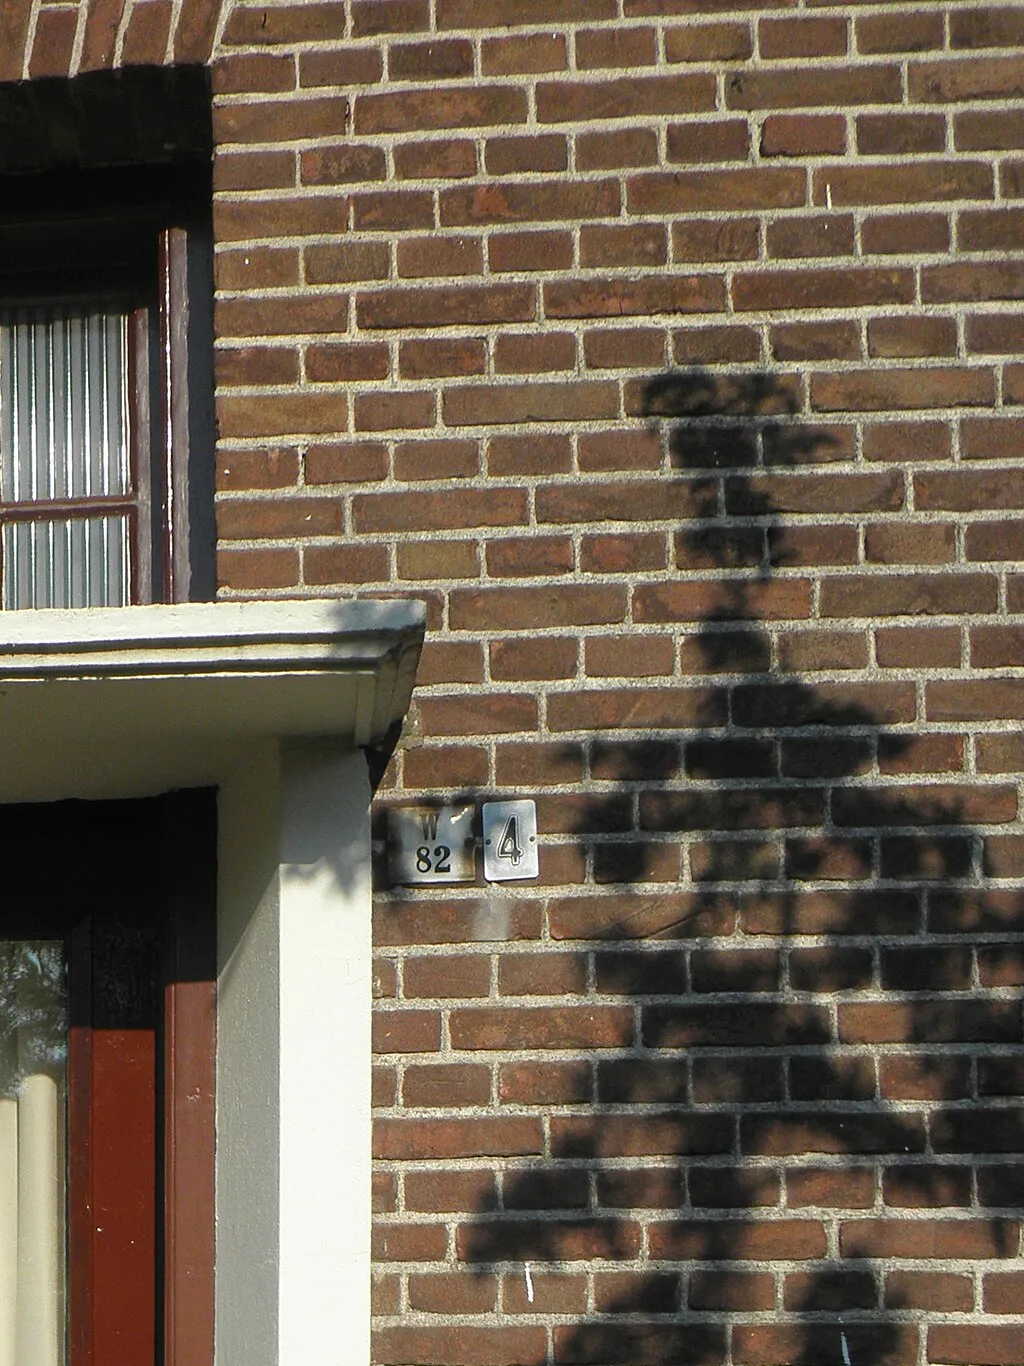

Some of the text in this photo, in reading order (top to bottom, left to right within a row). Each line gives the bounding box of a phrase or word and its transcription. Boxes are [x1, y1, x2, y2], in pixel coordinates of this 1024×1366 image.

[419, 813, 440, 841] W
[497, 814, 524, 866] 4
[416, 845, 451, 873] 82
